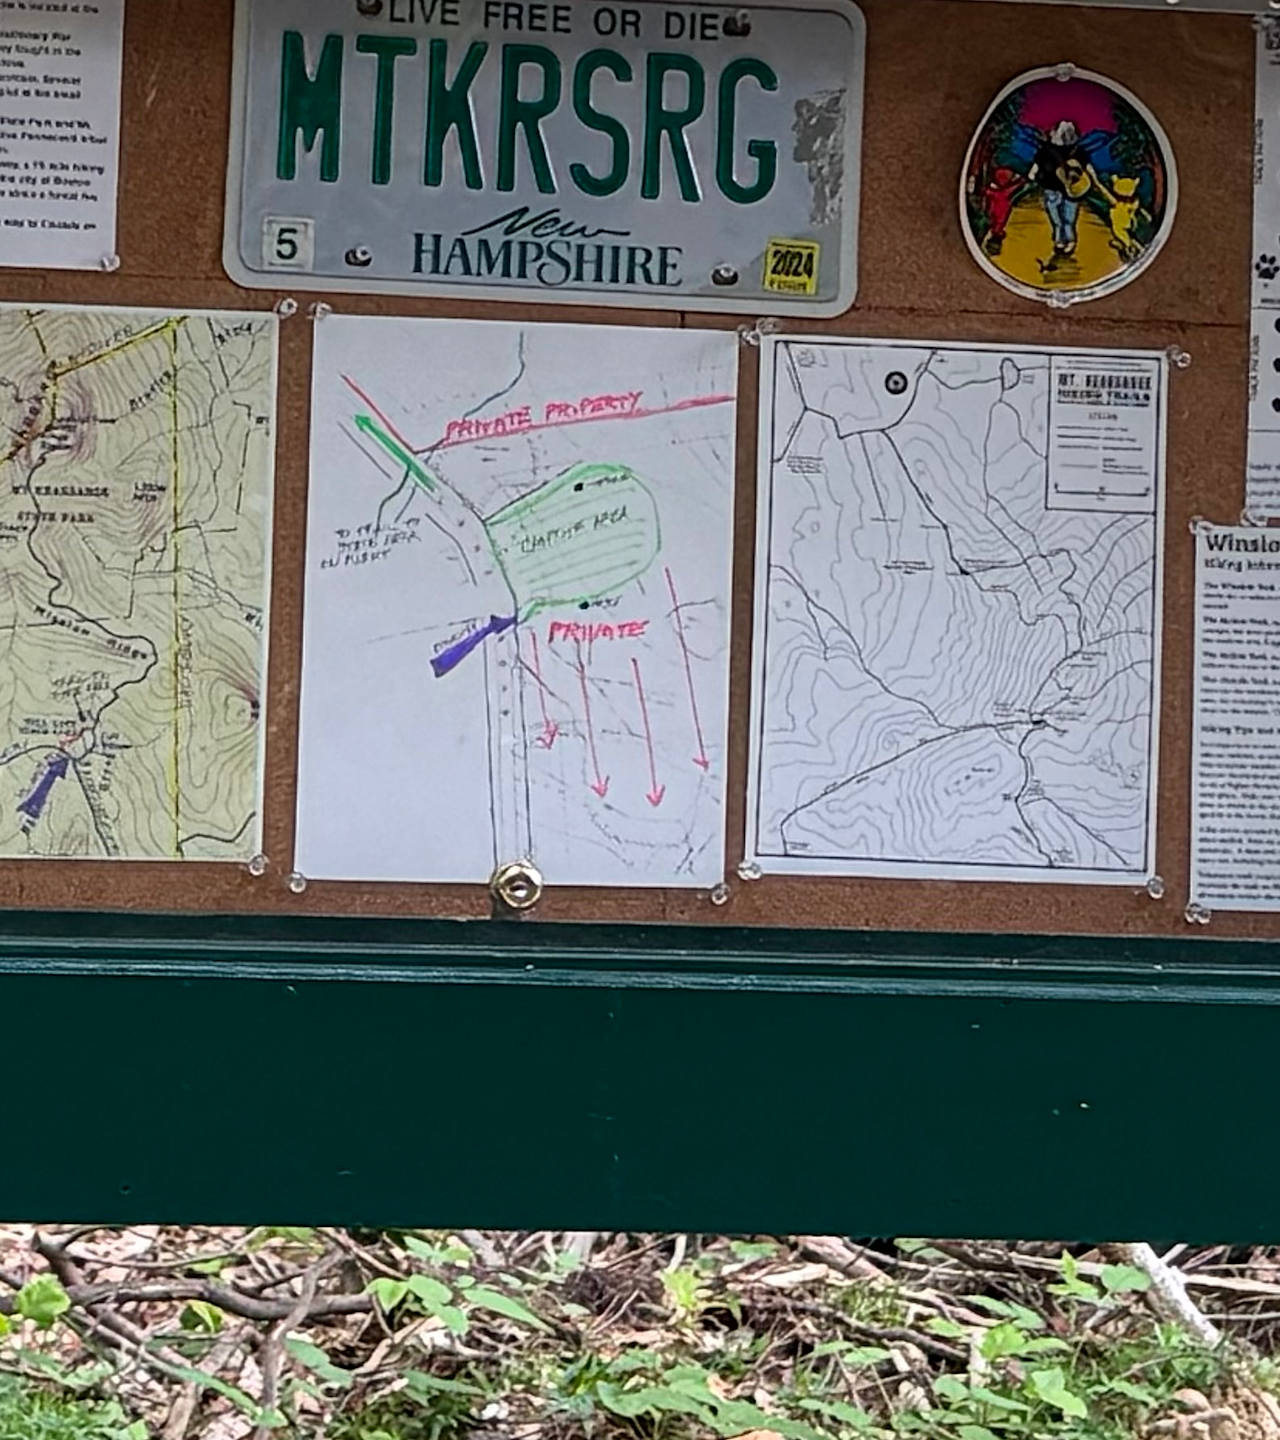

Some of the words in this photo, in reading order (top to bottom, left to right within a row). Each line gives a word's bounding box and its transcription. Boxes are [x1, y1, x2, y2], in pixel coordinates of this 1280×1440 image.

[483, 0, 572, 34] FREE
[593, 6, 641, 38] OR
[664, 11, 720, 42] DIE
[276, 29, 779, 207] MTKRSRG
[461, 205, 631, 239] New
[276, 227, 298, 262] 5
[412, 232, 684, 288] HAMPSHIRE
[771, 248, 815, 279] 2024
[445, 406, 532, 442] PRIVATE
[544, 391, 643, 422] PROPERTY
[548, 620, 650, 643] PRIVATE
